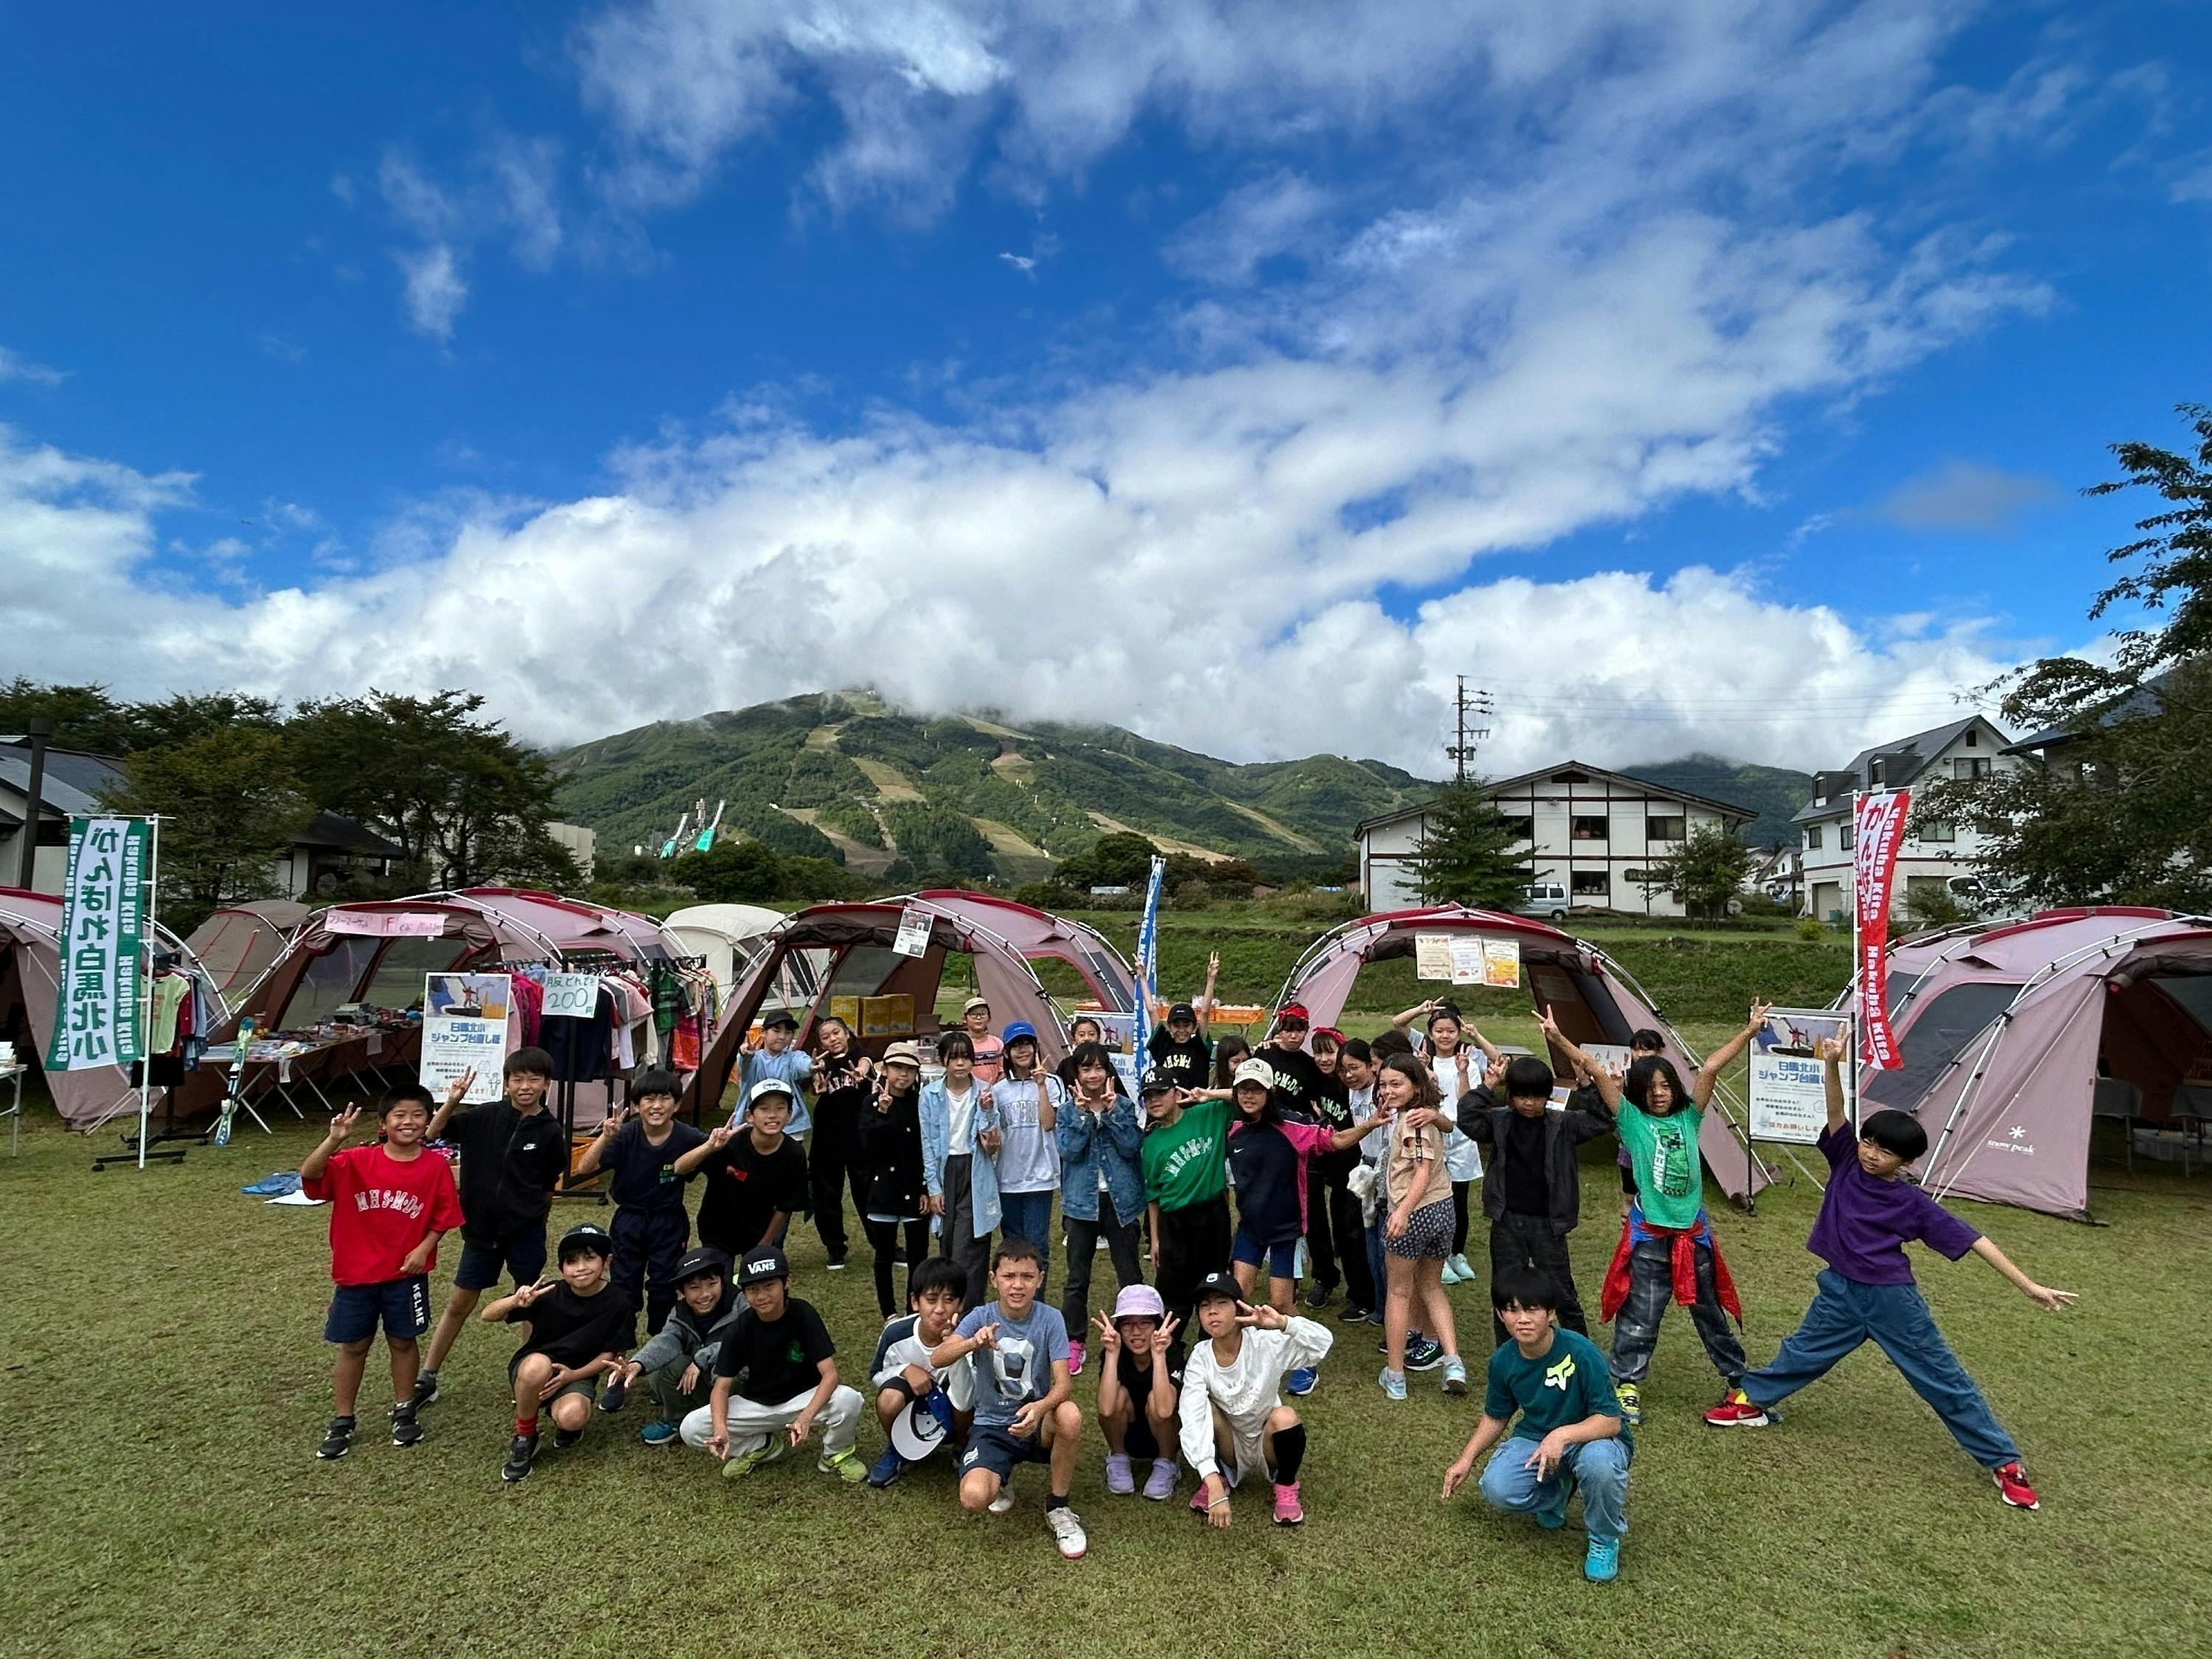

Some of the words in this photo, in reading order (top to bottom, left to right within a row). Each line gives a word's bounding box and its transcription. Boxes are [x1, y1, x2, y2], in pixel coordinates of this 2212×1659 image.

[1867, 945, 1881, 1018] Hakuba
[1871, 1021, 1891, 1060] Kita
[1988, 1140, 2011, 1148] snow
[2011, 1144, 2035, 1153] peak
[748, 1259, 776, 1274] VANS
[413, 1283, 425, 1326] KELME
